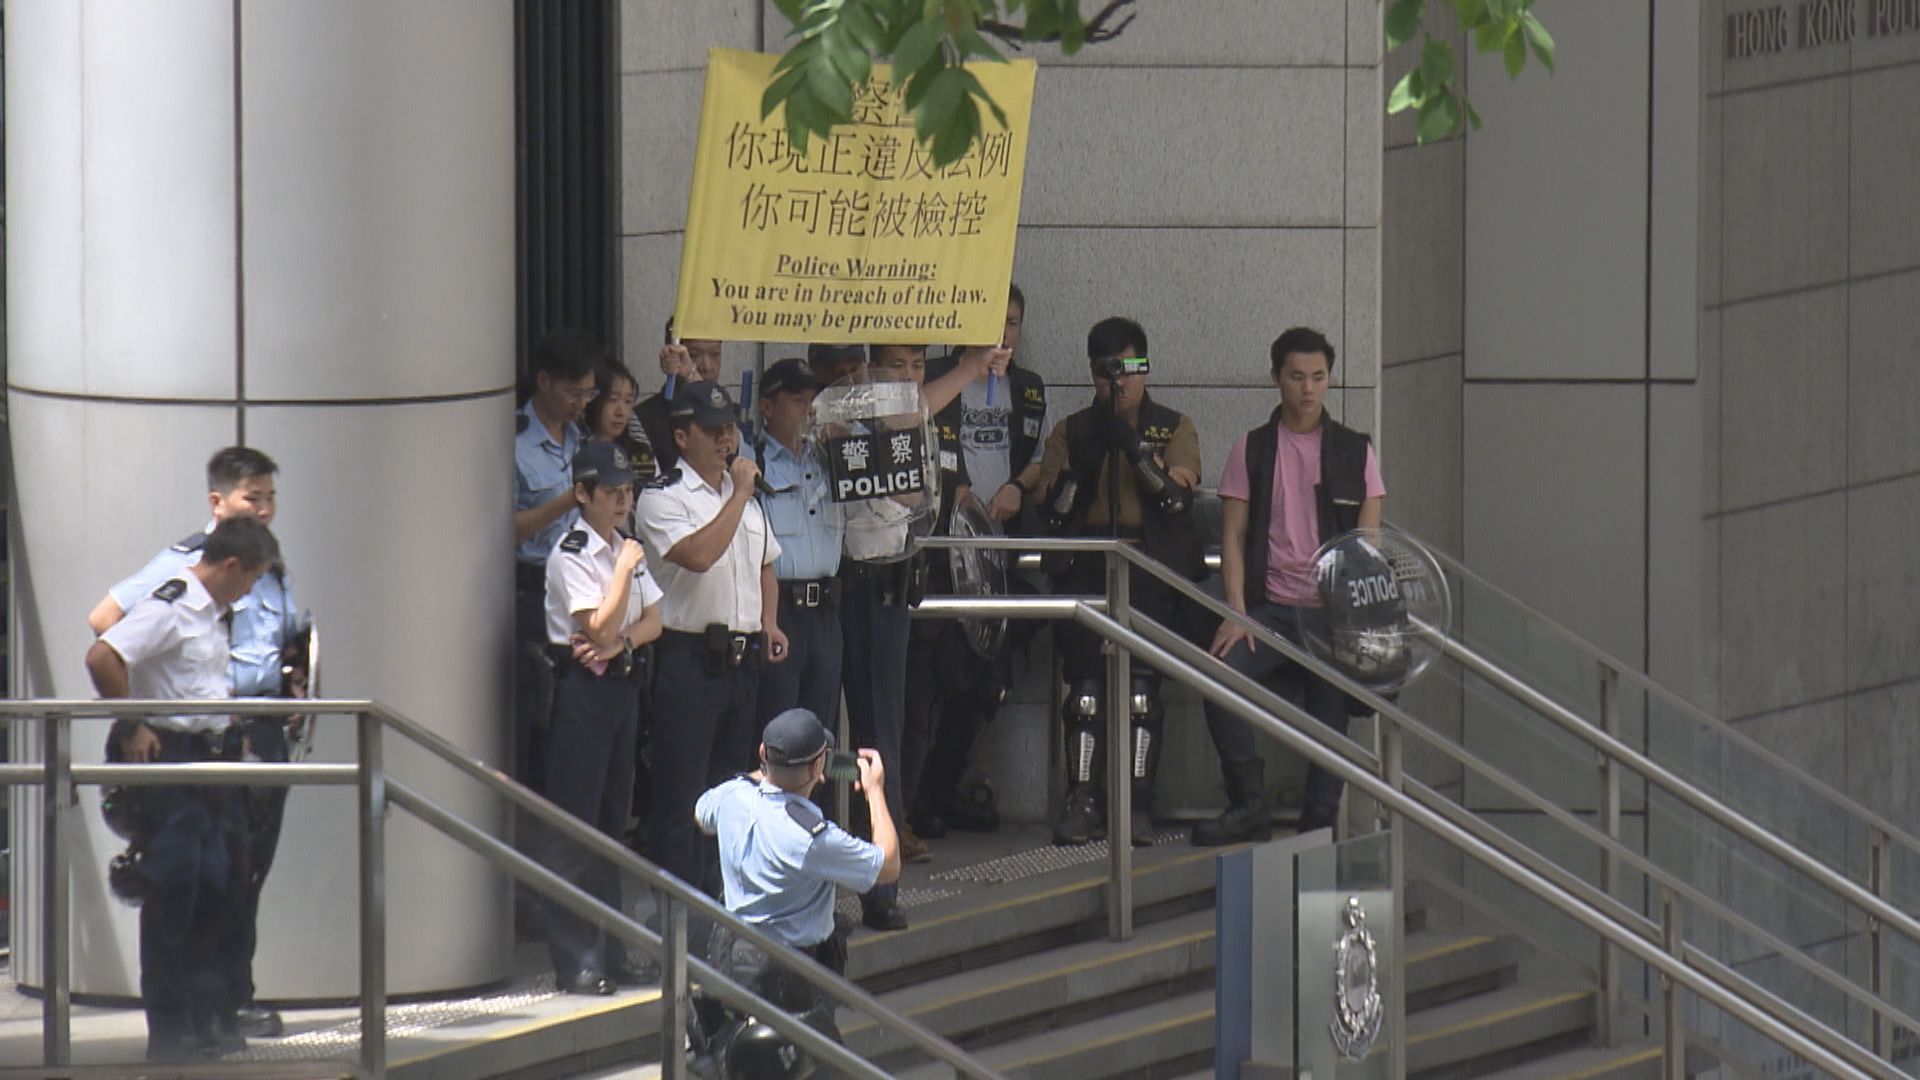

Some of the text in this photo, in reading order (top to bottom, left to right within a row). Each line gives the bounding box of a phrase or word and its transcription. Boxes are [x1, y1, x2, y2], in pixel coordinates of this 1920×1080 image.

[1732, 0, 1920, 57] HONG KONG POLI
[741, 182, 988, 240] 你可能被檢控
[776, 254, 938, 280] Police Warning:
[711, 277, 988, 305] You are in breach of the law.
[730, 304, 963, 333] You may be prosecuted.
[837, 468, 921, 500] POLICE
[1347, 574, 1399, 607] POLICE
